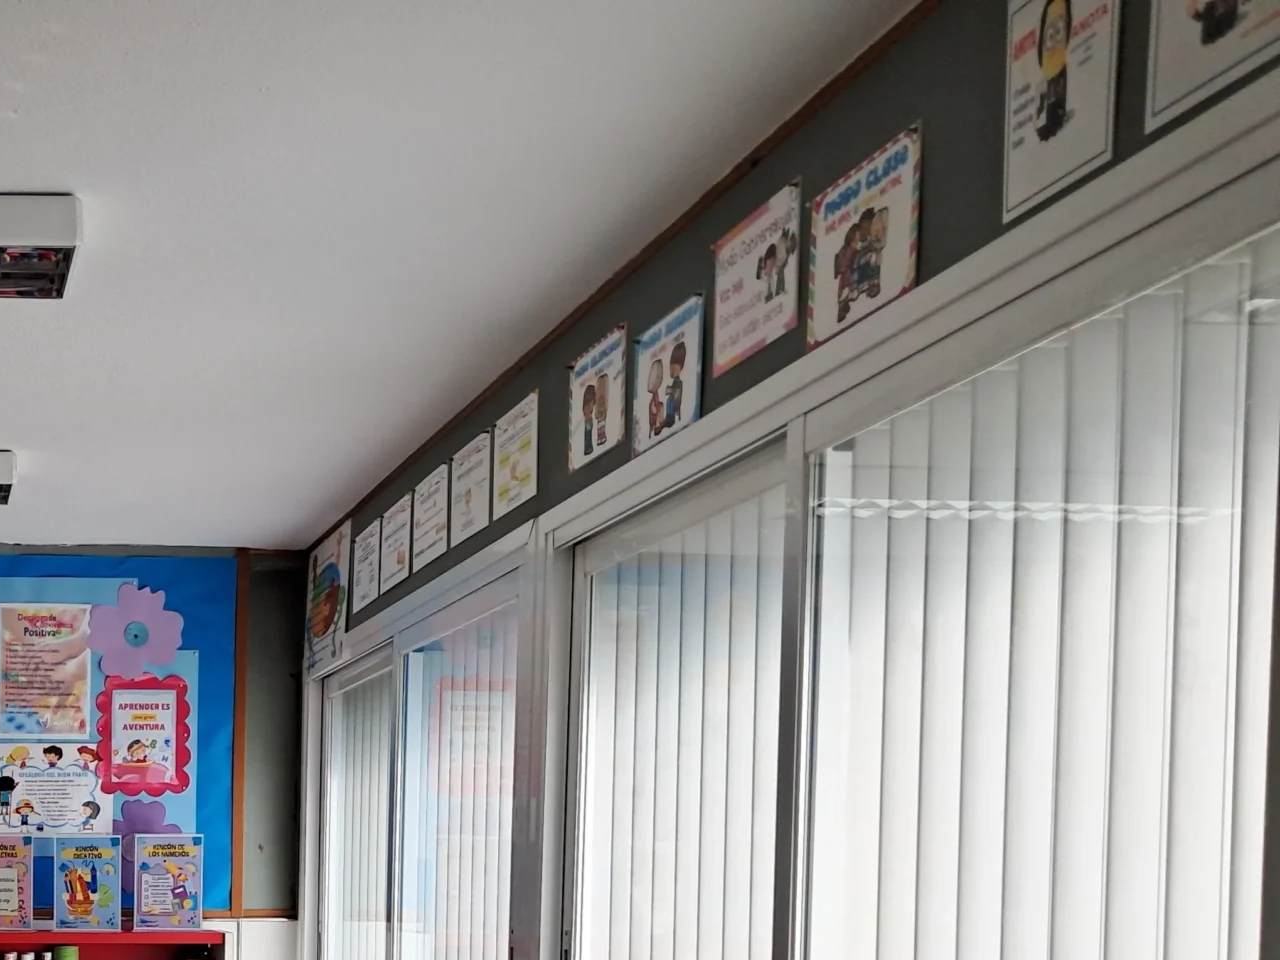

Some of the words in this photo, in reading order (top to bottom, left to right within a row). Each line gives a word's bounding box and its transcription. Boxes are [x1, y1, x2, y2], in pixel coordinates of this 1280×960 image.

[49, 613, 57, 621] de
[23, 627, 56, 637] Positiva
[118, 703, 159, 711] APRENDER
[161, 703, 171, 711] ES
[122, 723, 166, 731] AVENTURA
